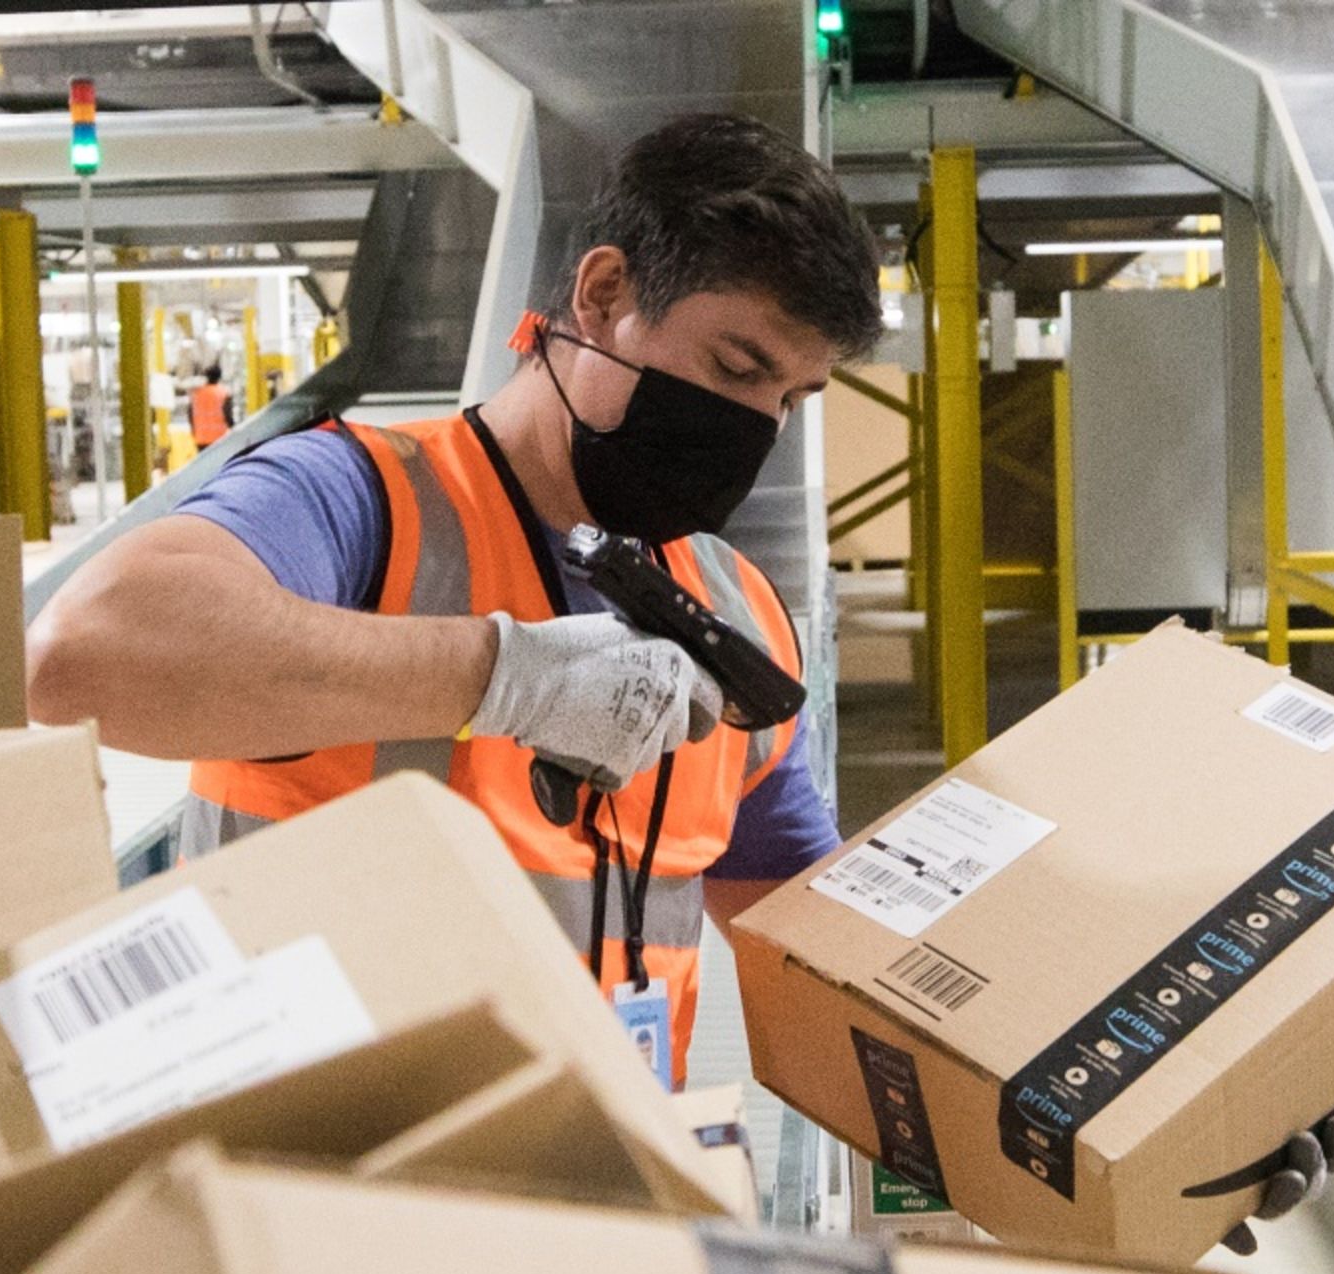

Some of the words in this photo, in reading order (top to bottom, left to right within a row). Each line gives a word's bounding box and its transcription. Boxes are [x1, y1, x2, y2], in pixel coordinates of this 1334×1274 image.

[1199, 931, 1255, 967] prime
[1109, 1007, 1166, 1045] prime
[1016, 1086, 1072, 1127] prime
[880, 1183, 920, 1195] Emerg
[901, 1197, 928, 1209] stop
